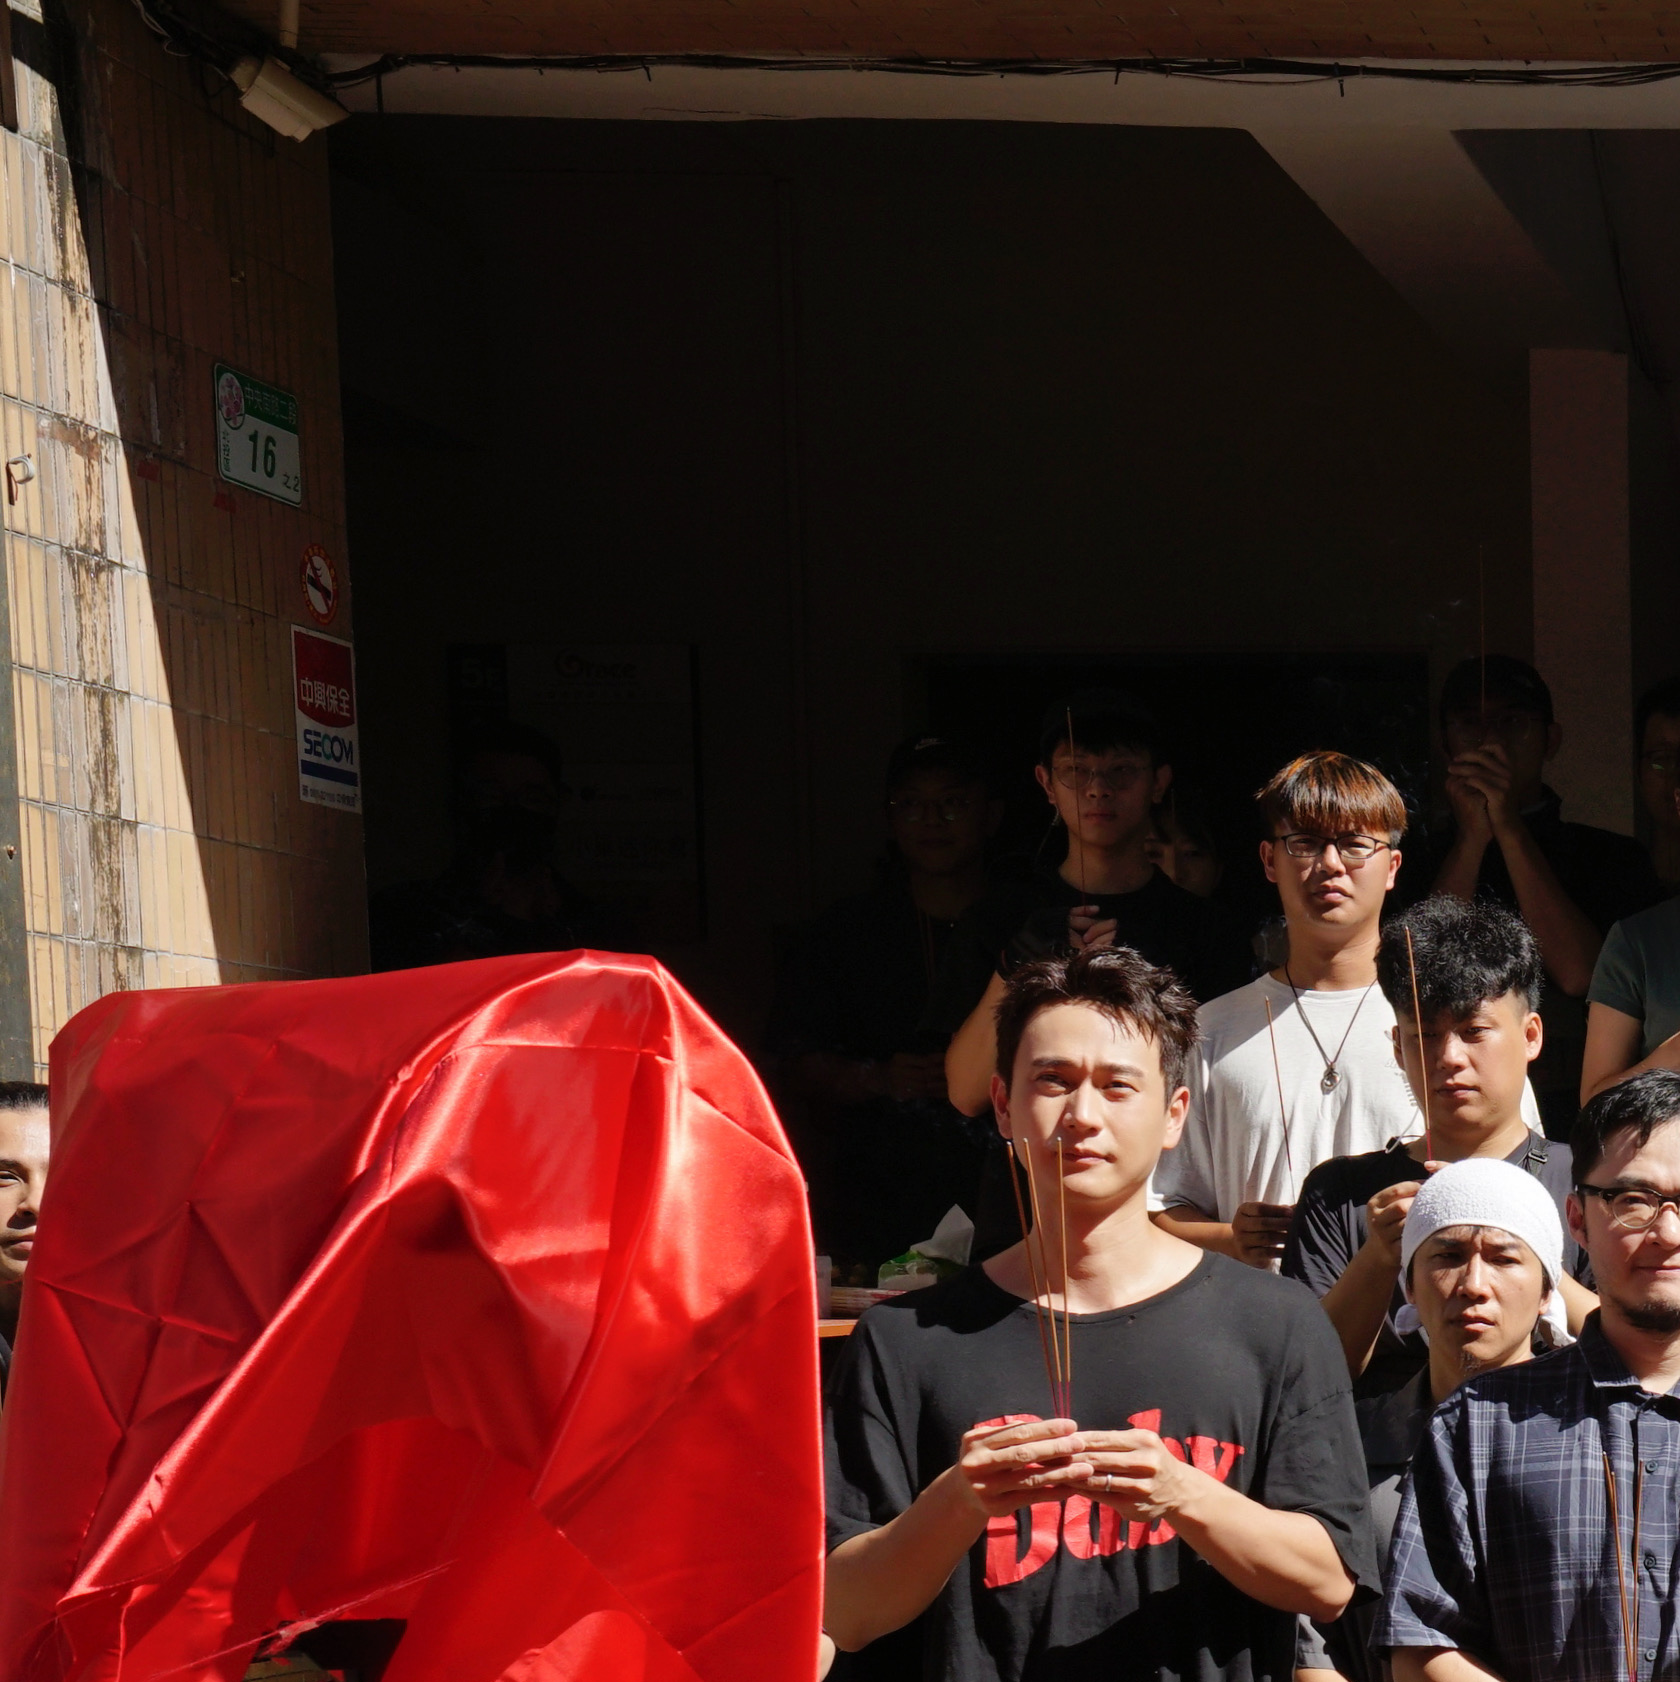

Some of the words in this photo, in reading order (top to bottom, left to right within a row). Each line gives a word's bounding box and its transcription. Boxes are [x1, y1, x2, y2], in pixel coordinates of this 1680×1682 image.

[249, 430, 276, 478] 16
[300, 677, 350, 717] 中興保全
[304, 729, 354, 765] SECOM
